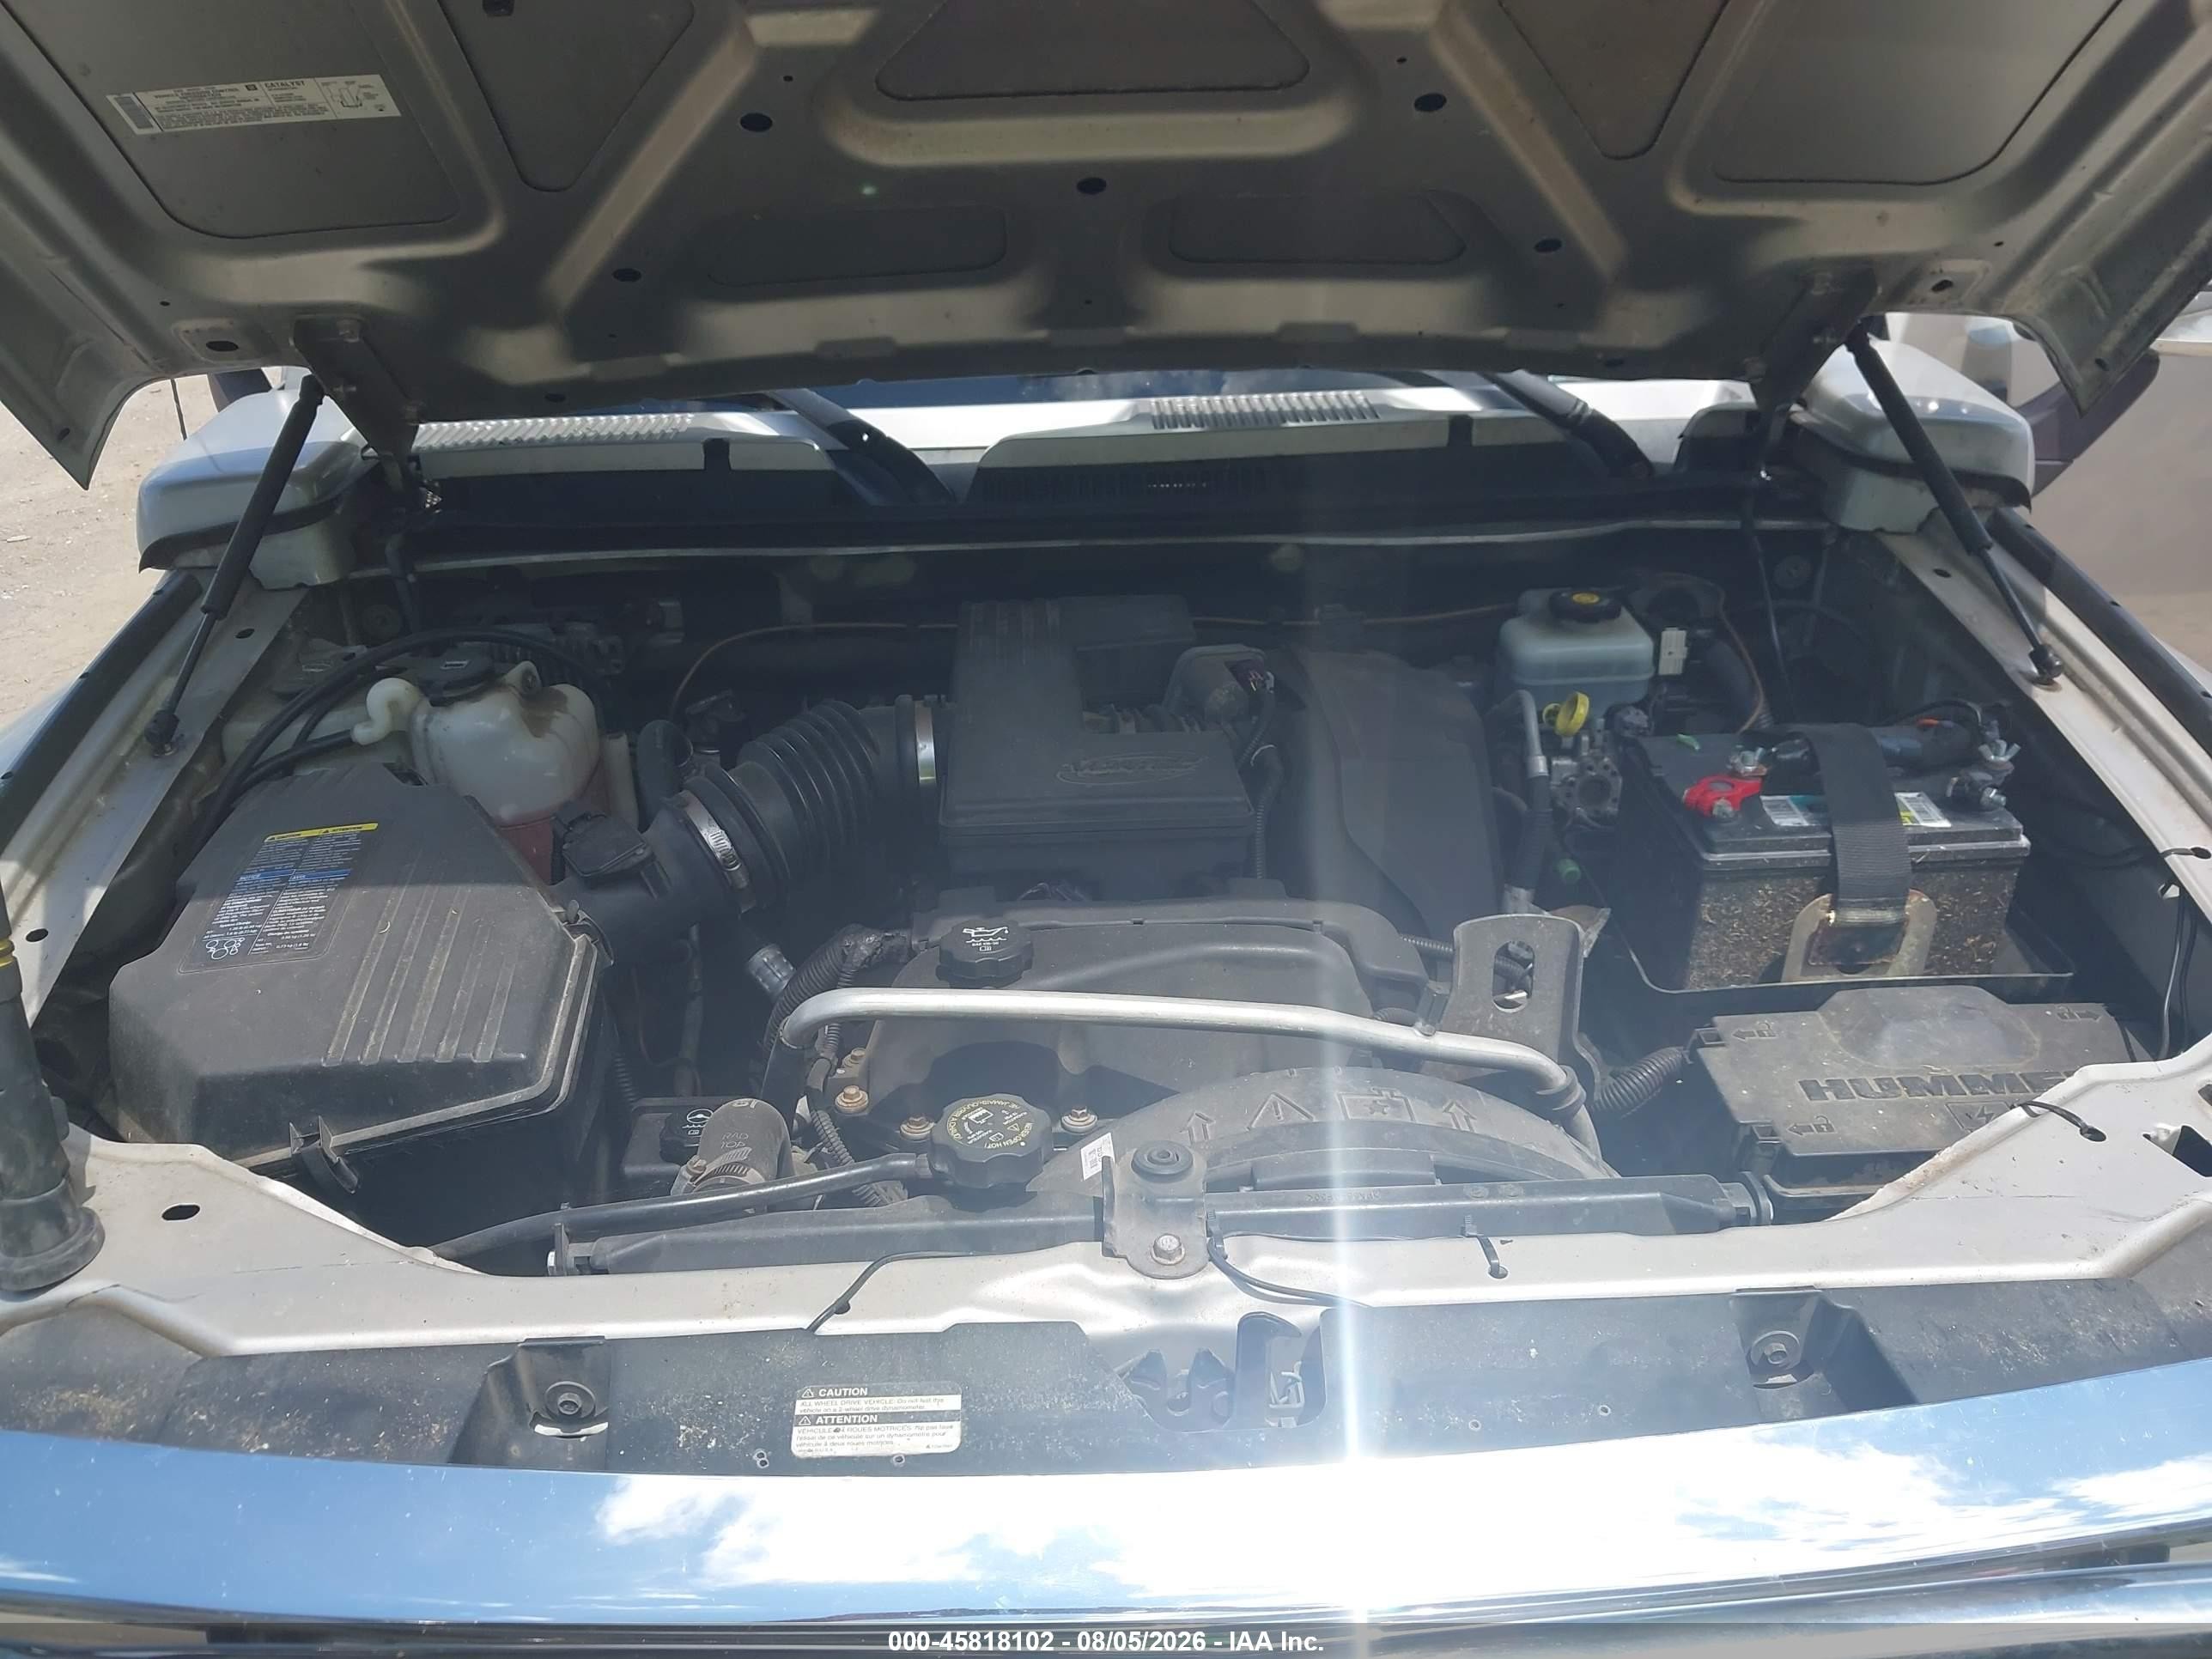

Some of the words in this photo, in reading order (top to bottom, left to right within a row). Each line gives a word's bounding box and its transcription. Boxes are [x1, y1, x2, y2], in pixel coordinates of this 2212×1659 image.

[1797, 1071, 2072, 1102] HUMME
[818, 1387, 868, 1397] CAUTION
[815, 1415, 878, 1424] ATTENTION
